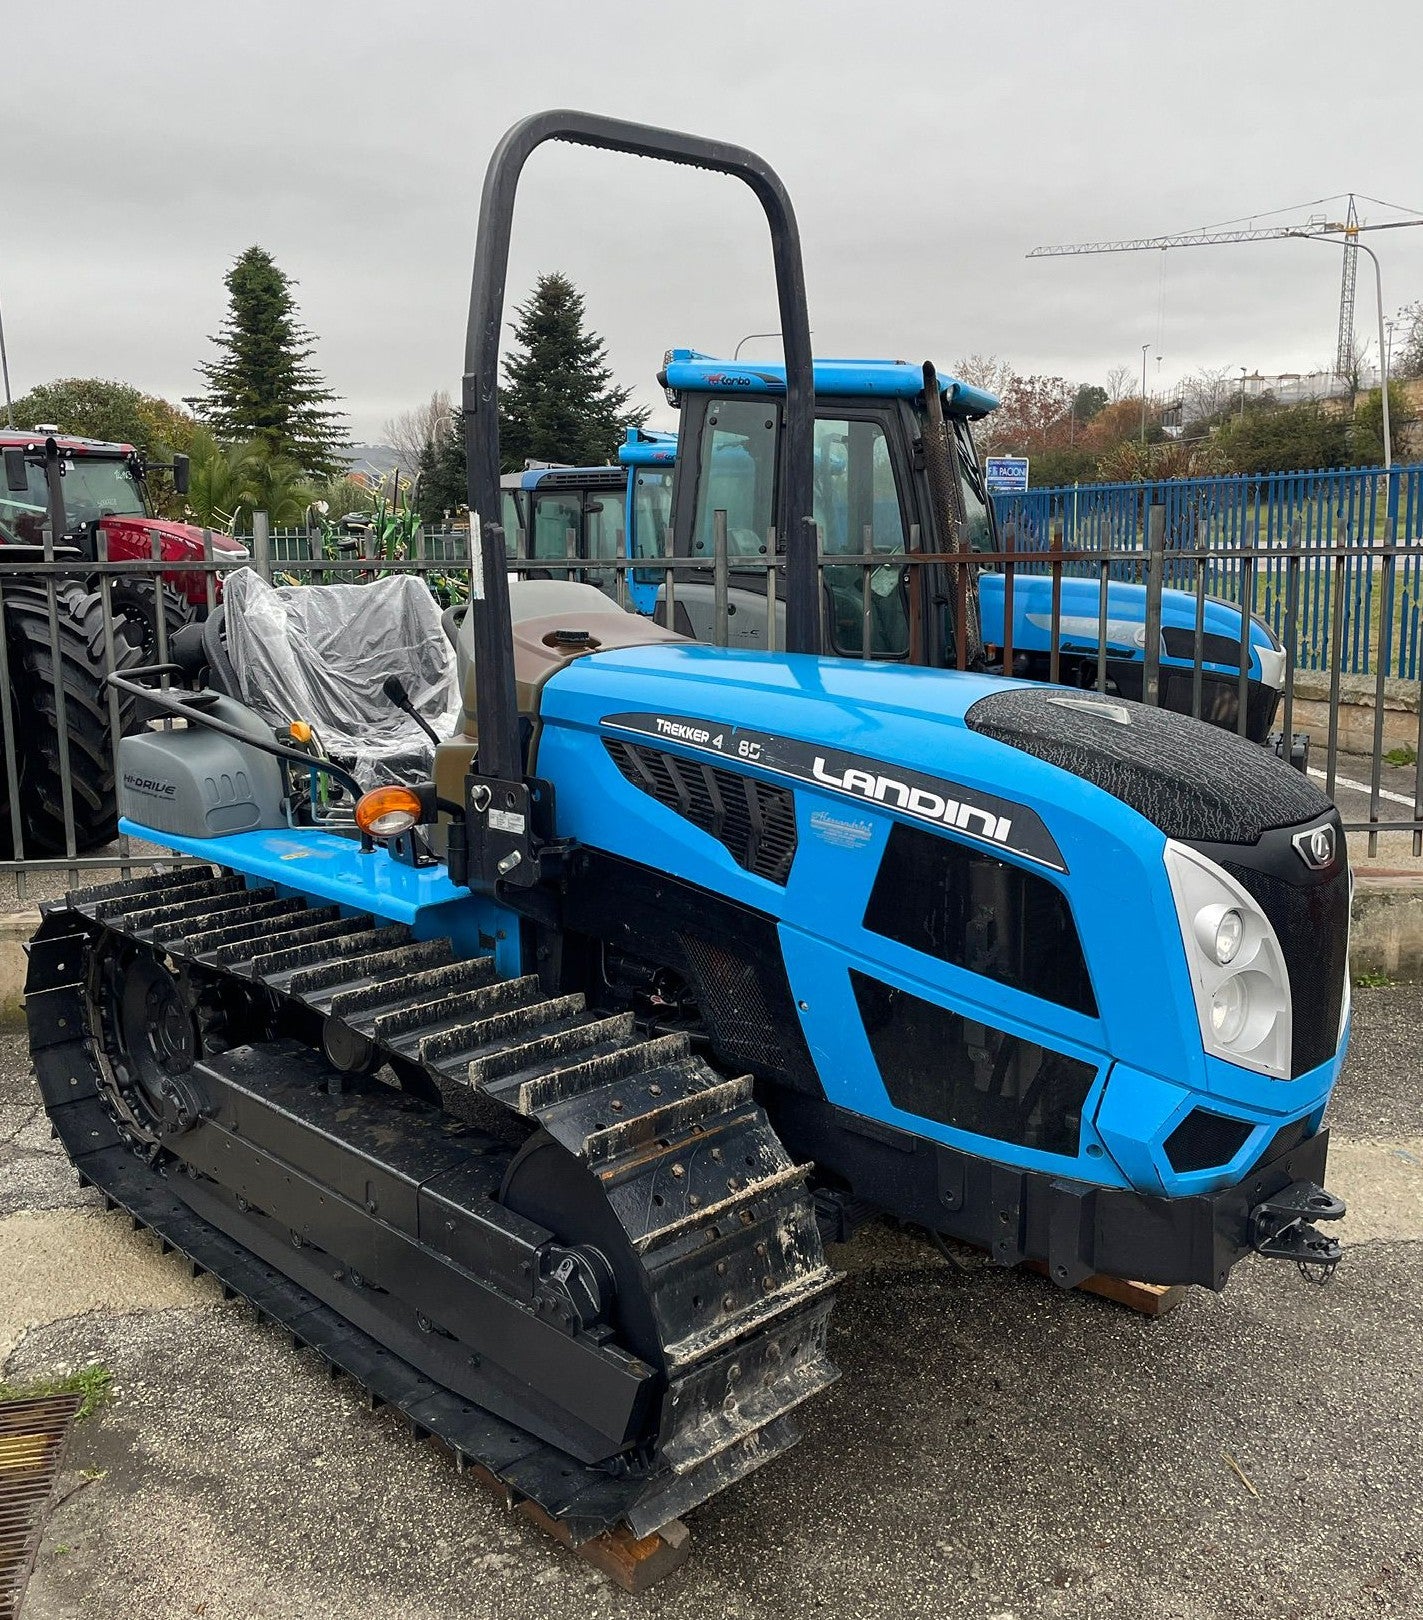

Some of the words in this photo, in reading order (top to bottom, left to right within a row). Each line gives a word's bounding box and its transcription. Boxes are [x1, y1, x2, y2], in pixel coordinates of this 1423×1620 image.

[656, 718, 710, 743] TREKKER
[712, 734, 724, 750] 4
[738, 740, 761, 760] 85
[812, 756, 1013, 842] LANDINI
